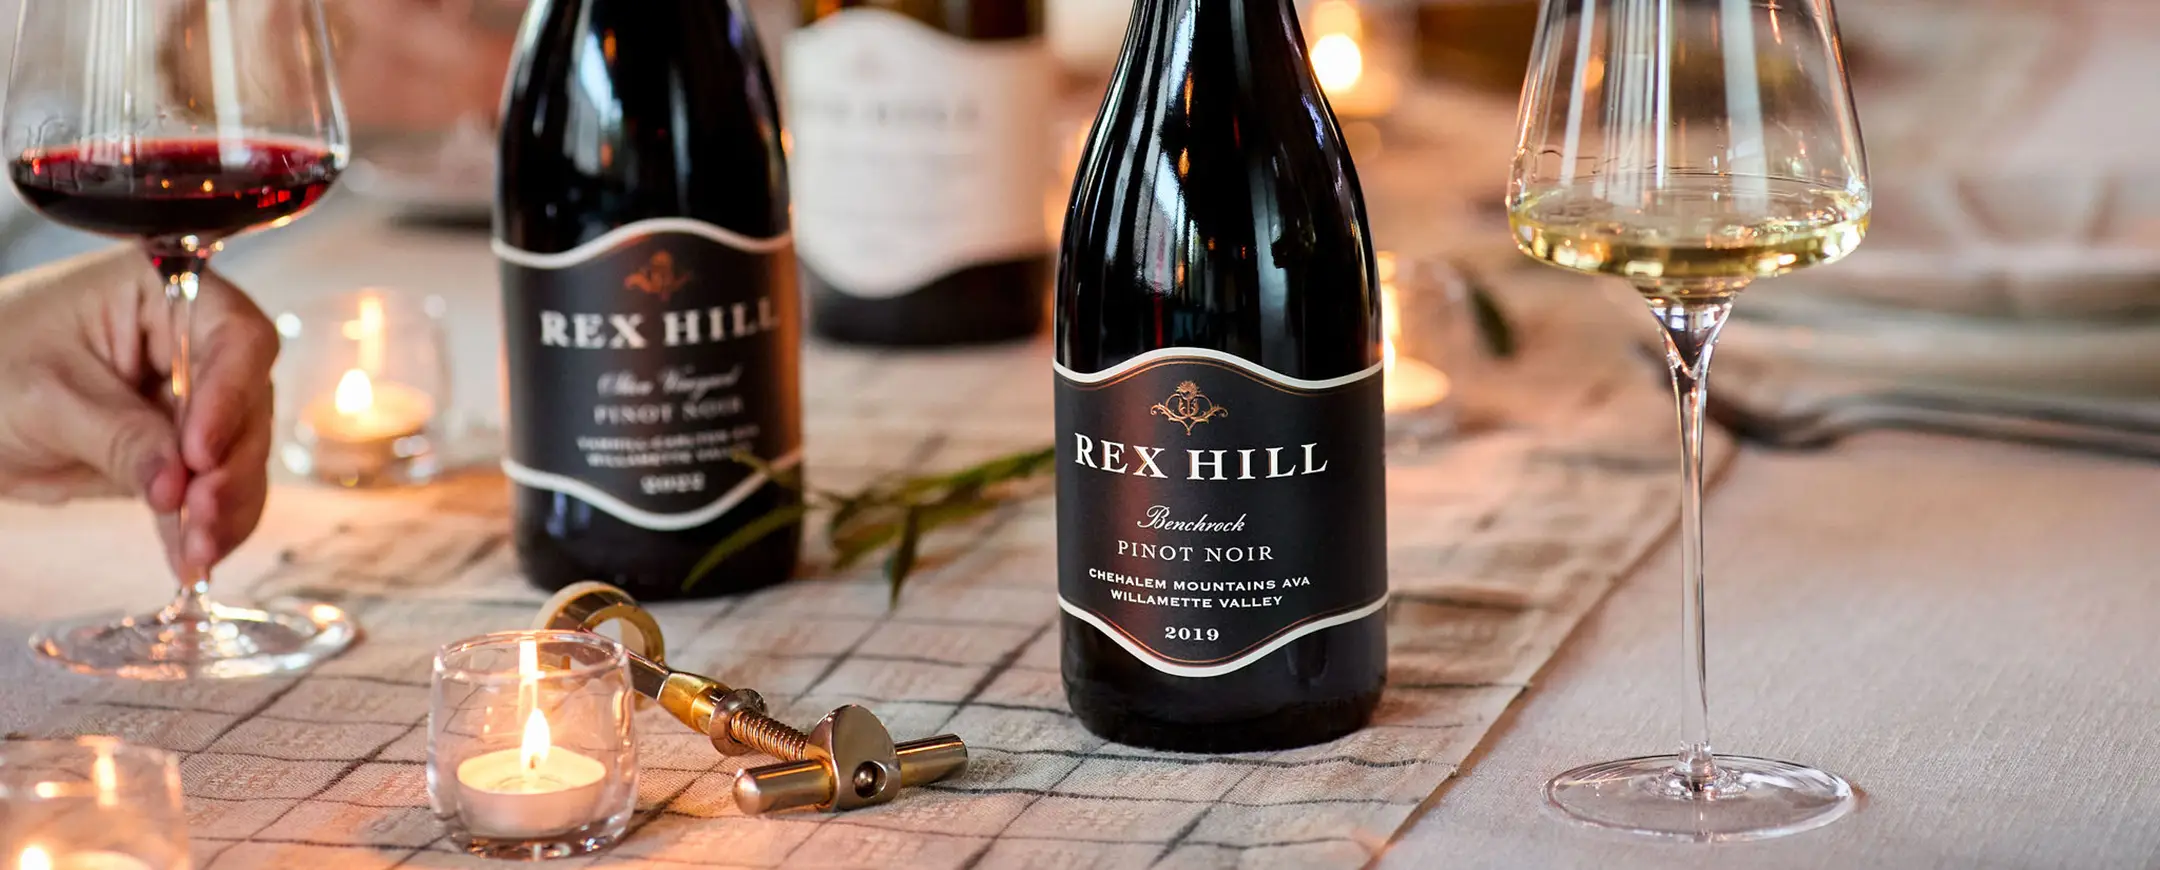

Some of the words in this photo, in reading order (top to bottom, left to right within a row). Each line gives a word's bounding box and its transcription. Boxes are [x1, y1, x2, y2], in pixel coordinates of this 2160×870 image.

[540, 311, 647, 348] REX
[662, 297, 780, 347] HILL
[593, 405, 673, 425] PINOT
[682, 396, 741, 420] NOIR
[1074, 432, 1168, 479] REX
[1186, 442, 1328, 481] HILL
[1136, 504, 1247, 533] Benchrock
[1117, 539, 1194, 562] PINOT
[1204, 545, 1275, 563] NOIR
[1088, 567, 1167, 590] CHEHALEM
[1173, 580, 1276, 592] MOUNTAINS
[1282, 576, 1311, 589] AVA
[1110, 589, 1213, 608] WILLAMETTE
[1218, 595, 1283, 609] VALLEY
[1164, 626, 1220, 642] 2019
